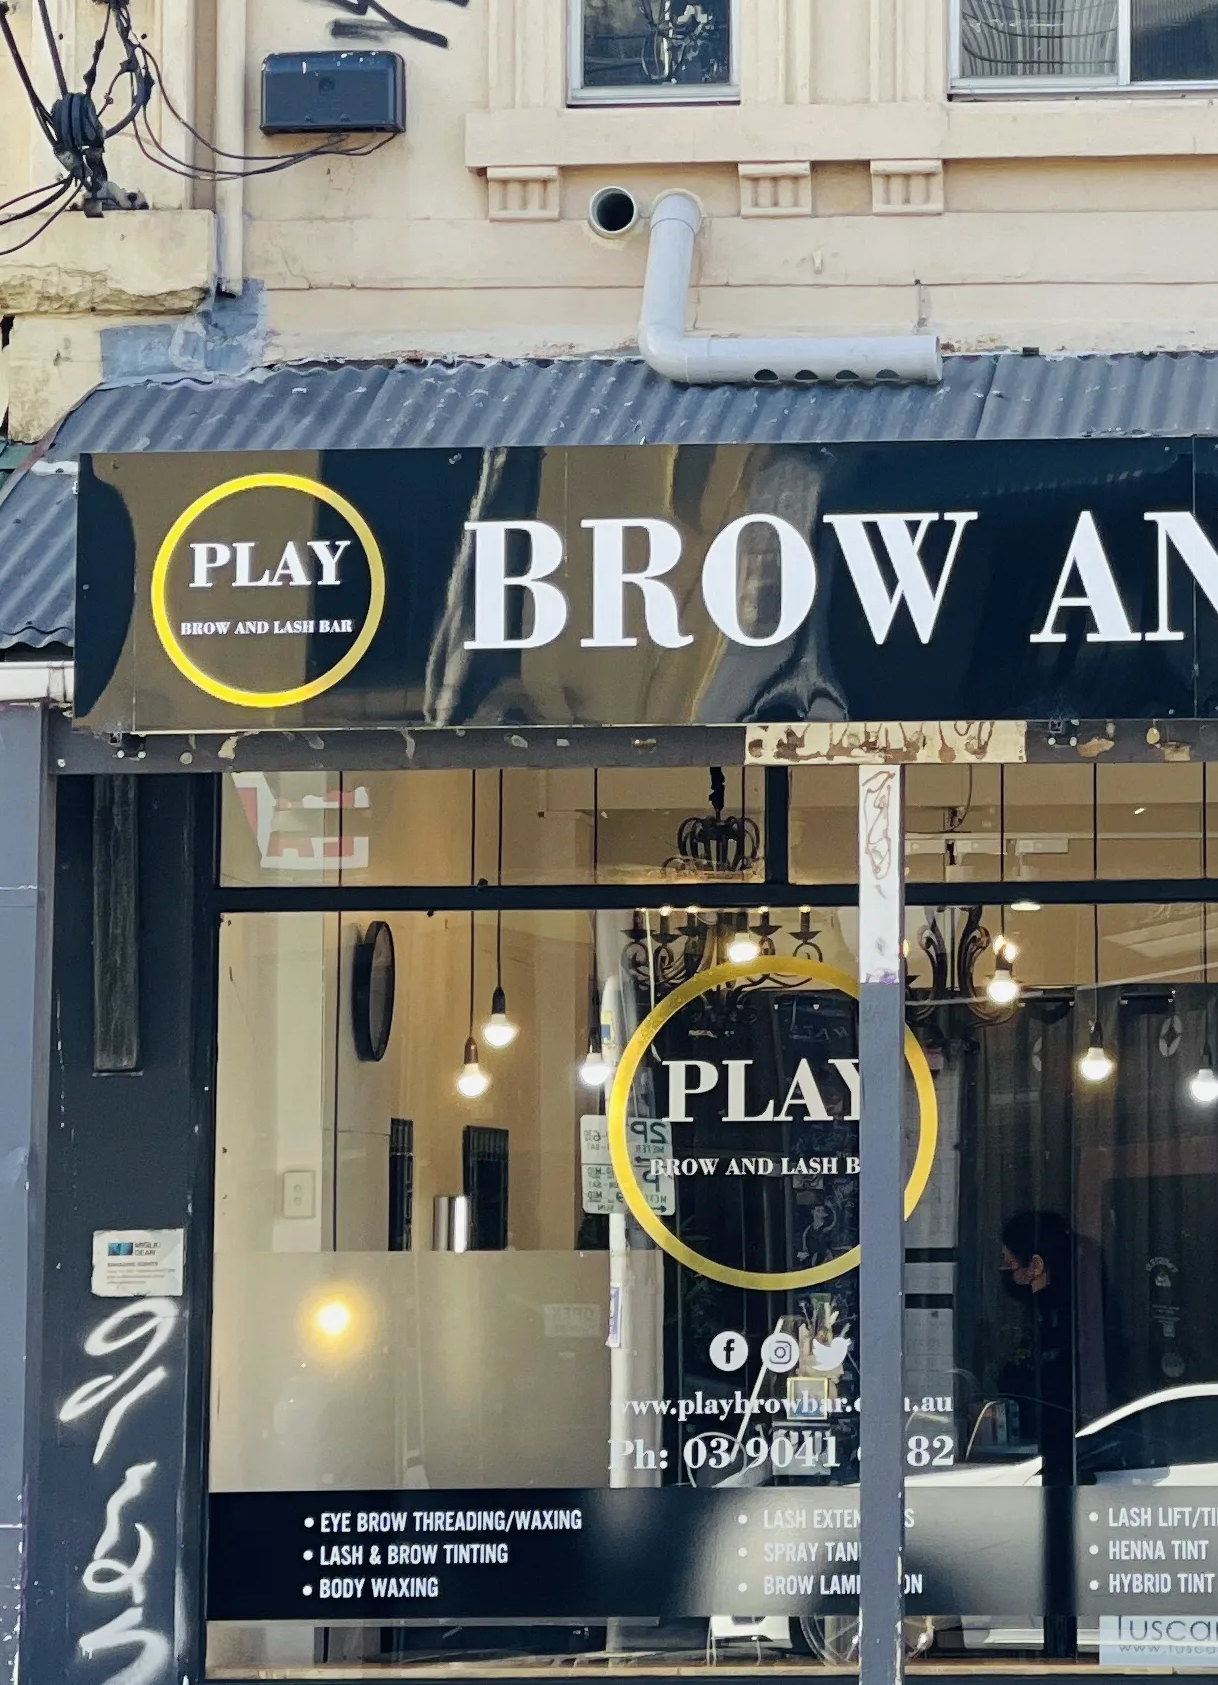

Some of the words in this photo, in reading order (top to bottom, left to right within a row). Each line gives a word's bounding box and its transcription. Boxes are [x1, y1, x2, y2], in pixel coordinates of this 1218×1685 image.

[189, 541, 351, 588] PLAY
[464, 511, 978, 649] BROW
[180, 621, 231, 636] BROW
[234, 620, 270, 635] AND
[273, 619, 315, 634] LASH
[319, 619, 353, 633] BAR
[650, 1158, 719, 1176] BROW
[725, 1158, 774, 1176] AND
[781, 1157, 838, 1175] LASH
[611, 1390, 953, 1421] www.playbrowbar.c.au
[608, 1438, 668, 1470] Ph:
[683, 1437, 731, 1469] 03
[746, 1435, 840, 1468] 9041
[320, 1512, 351, 1533] EYE
[357, 1511, 408, 1532] BROW
[412, 1509, 582, 1533] THREADING/WAXING
[763, 1508, 807, 1529] LASH
[1108, 1506, 1151, 1527] LASH
[320, 1545, 364, 1565] LASH
[369, 1545, 382, 1565] &
[387, 1544, 438, 1565] BROW
[443, 1543, 509, 1564] TINTING
[763, 1541, 819, 1562] SPRAY
[1108, 1540, 1166, 1560] HENNA
[1171, 1540, 1209, 1560] TINT
[319, 1577, 366, 1598] BODY
[371, 1576, 439, 1598] WAXING
[763, 1574, 815, 1595] BROW
[1108, 1573, 1172, 1594] HYBRID
[1177, 1573, 1215, 1594] TINT
